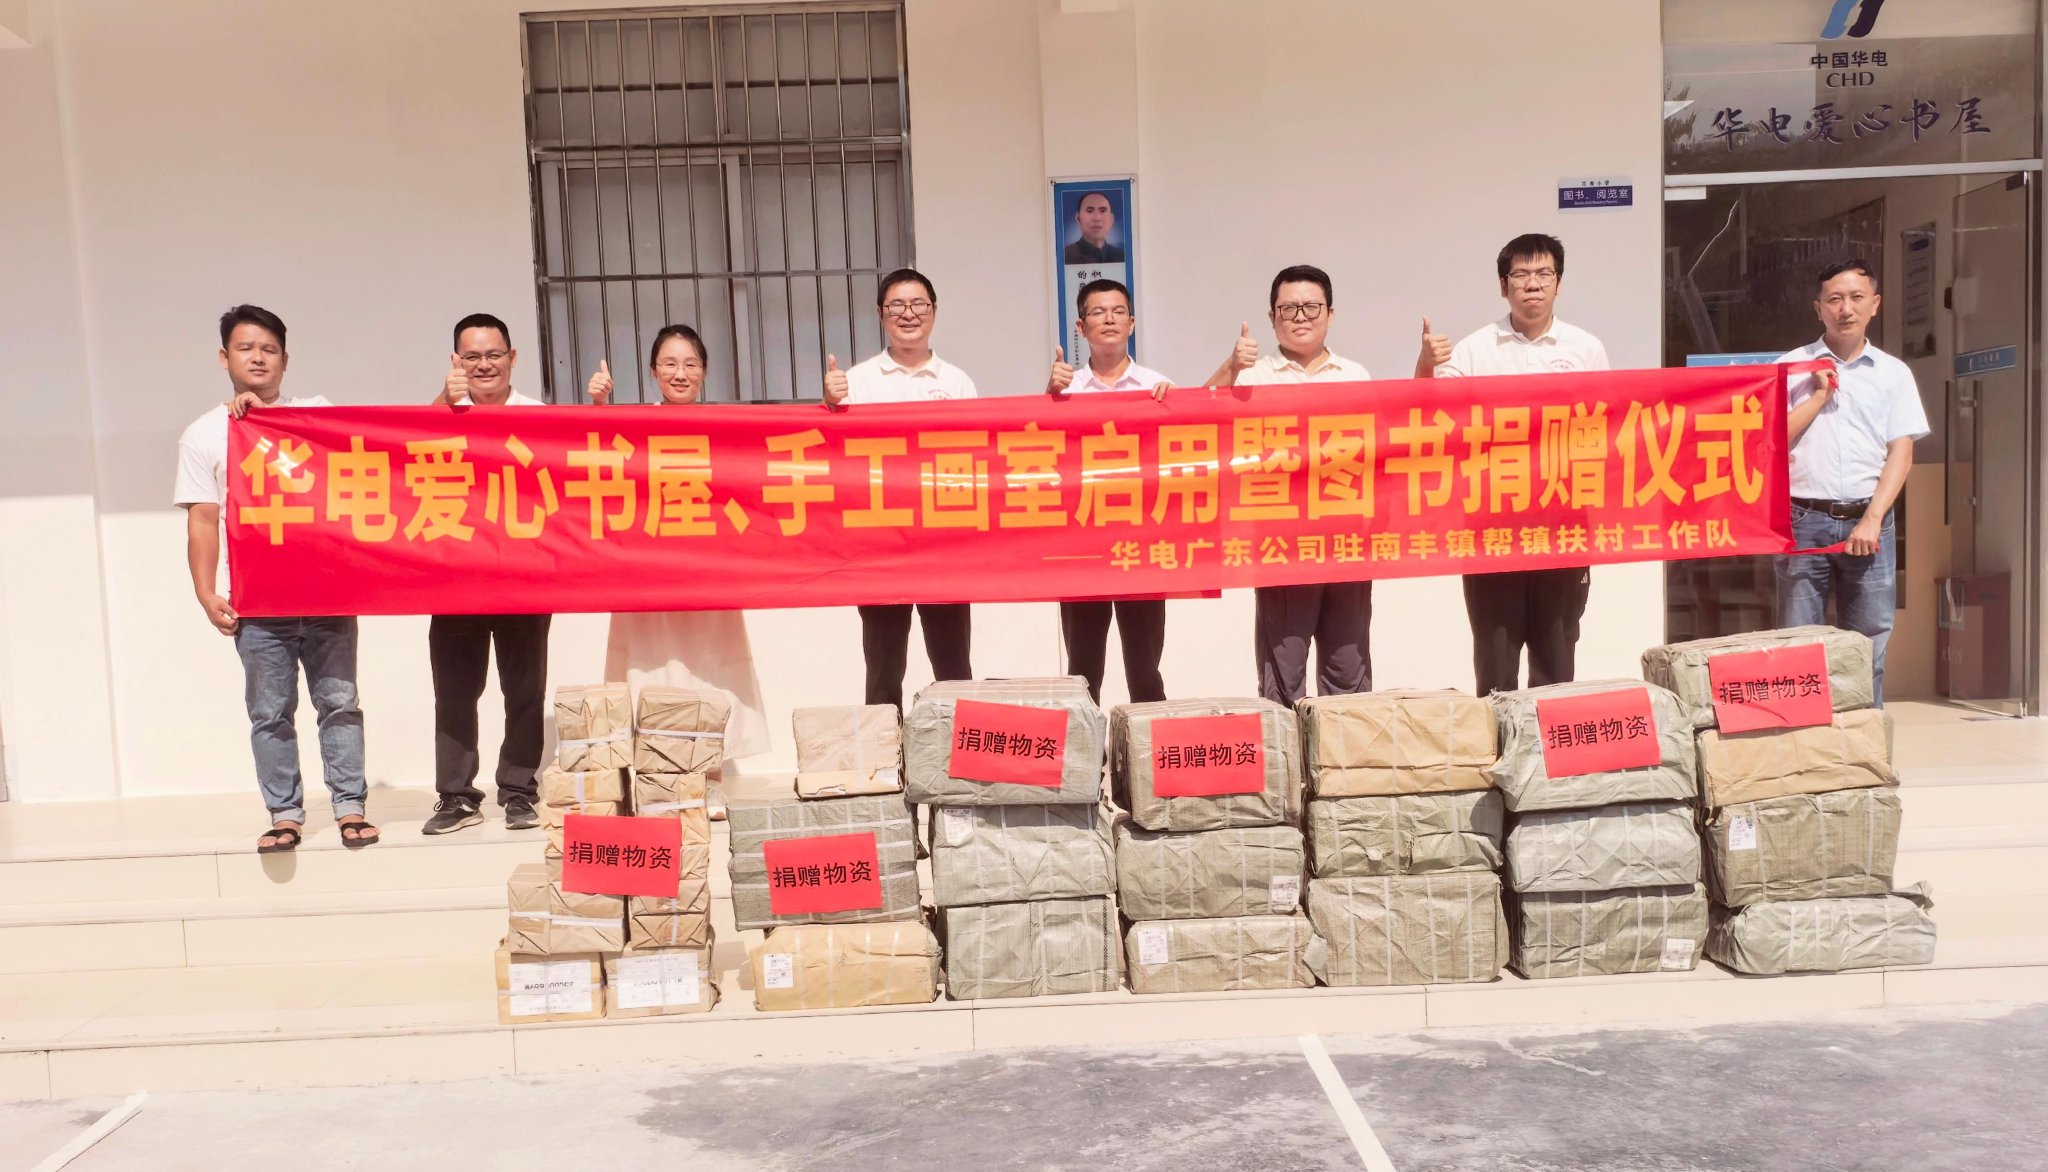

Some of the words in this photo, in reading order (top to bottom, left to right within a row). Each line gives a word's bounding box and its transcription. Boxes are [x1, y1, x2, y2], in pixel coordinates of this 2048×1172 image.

[1810, 50, 1889, 69] 中国华电
[1825, 71, 1875, 88] CHD
[1711, 97, 1991, 151] 华电爱心书屋
[239, 394, 1765, 546] 华电爱心书屋、手工画室启用暨图书捐赠仪式
[1719, 673, 1822, 704] 捐赠物资
[957, 726, 1058, 760] 捐赠物资
[1547, 715, 1649, 749] 捐赠物资
[1157, 741, 1257, 769] 捐赠物资
[569, 840, 672, 869] 捐赠物资
[773, 860, 872, 888] 捐赠物资
